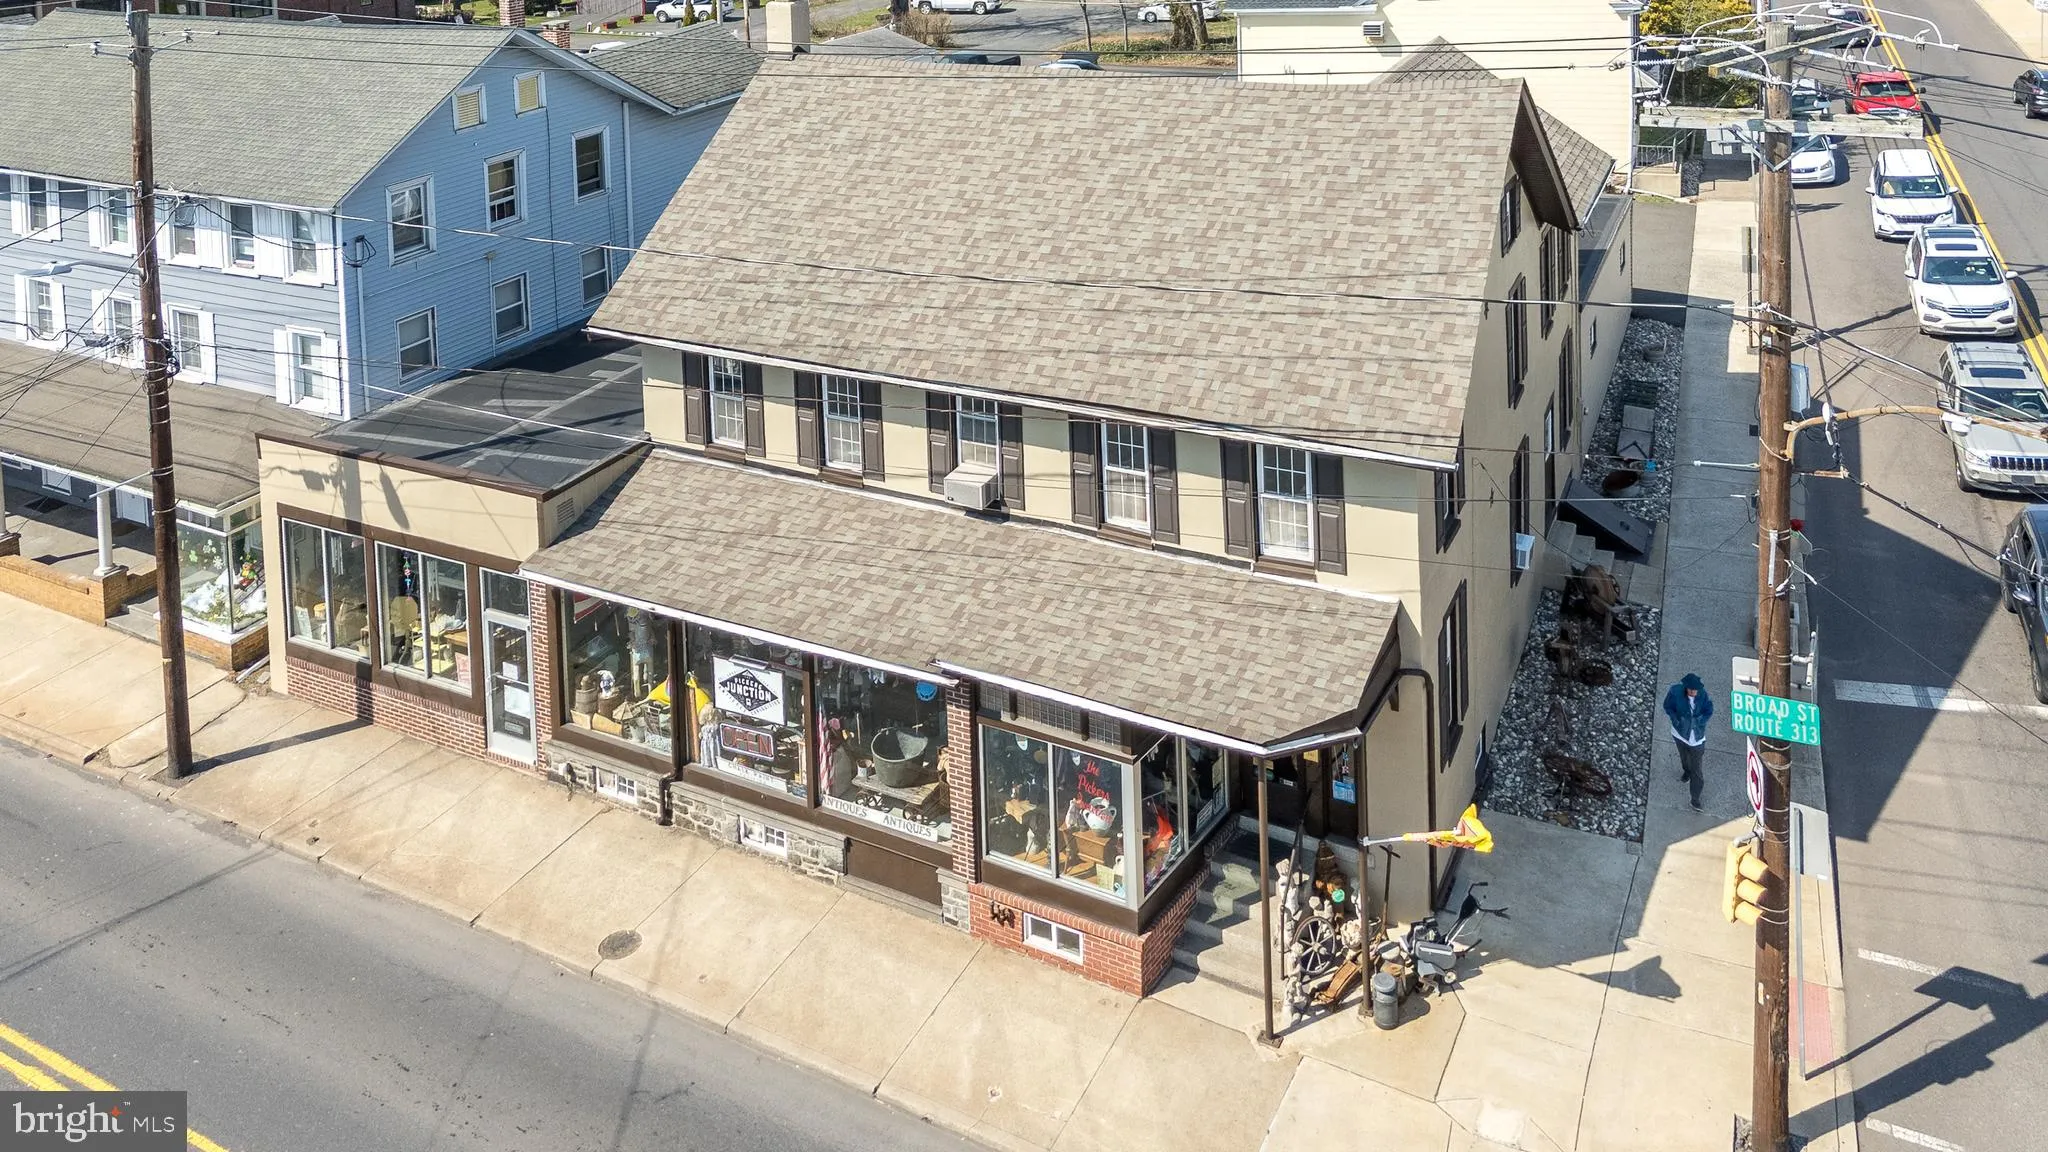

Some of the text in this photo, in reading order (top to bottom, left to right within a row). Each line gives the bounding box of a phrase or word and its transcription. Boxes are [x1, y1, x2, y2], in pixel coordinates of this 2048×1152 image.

[725, 681, 772, 702] JUNCTION
[1733, 693, 1817, 723] BROAD ST
[722, 726, 773, 757] OPEN
[1734, 713, 1818, 744] ROUTE 313
[822, 796, 932, 837] ANTIQUES ANTIQUES
